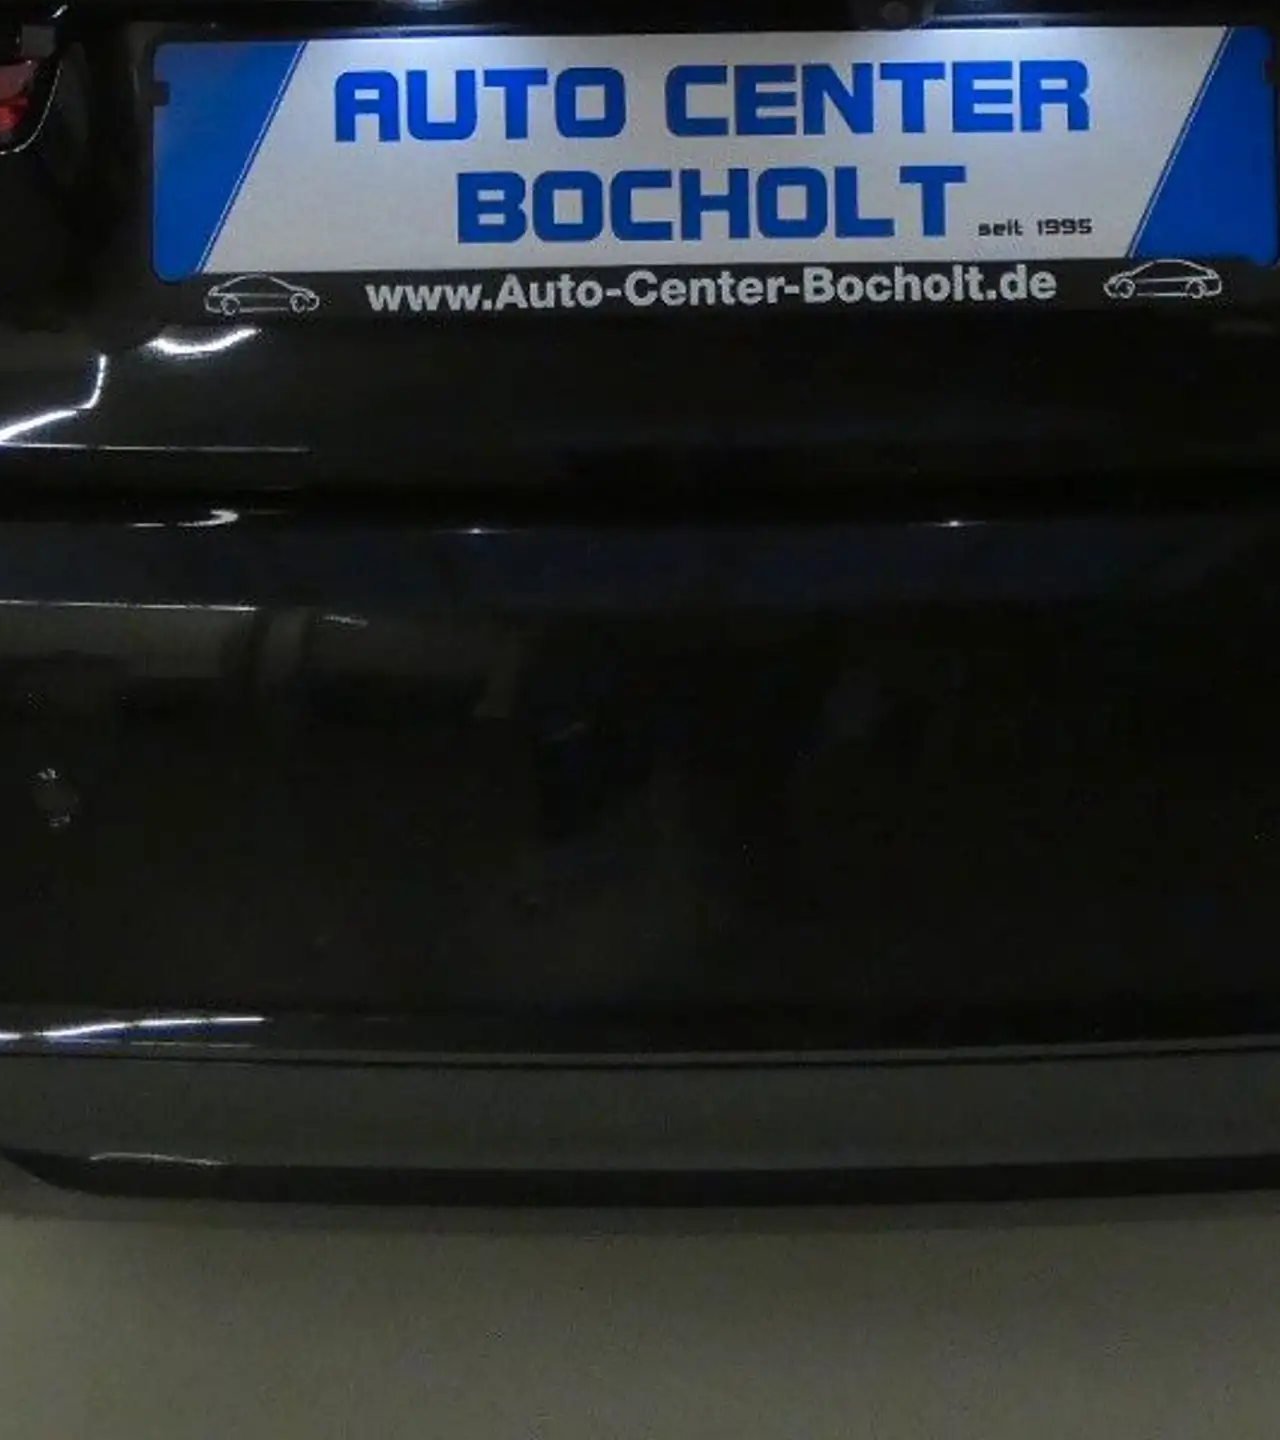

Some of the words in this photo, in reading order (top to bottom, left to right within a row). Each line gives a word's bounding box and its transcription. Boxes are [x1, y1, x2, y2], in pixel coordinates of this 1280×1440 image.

[334, 66, 627, 143] AUTO
[664, 60, 1091, 138] CENTER
[456, 165, 967, 244] BOCHOLT
[977, 218, 1023, 237] seit
[1035, 217, 1093, 236] 1995
[365, 263, 1058, 312] www.Auto-Center-Bocholt.de
